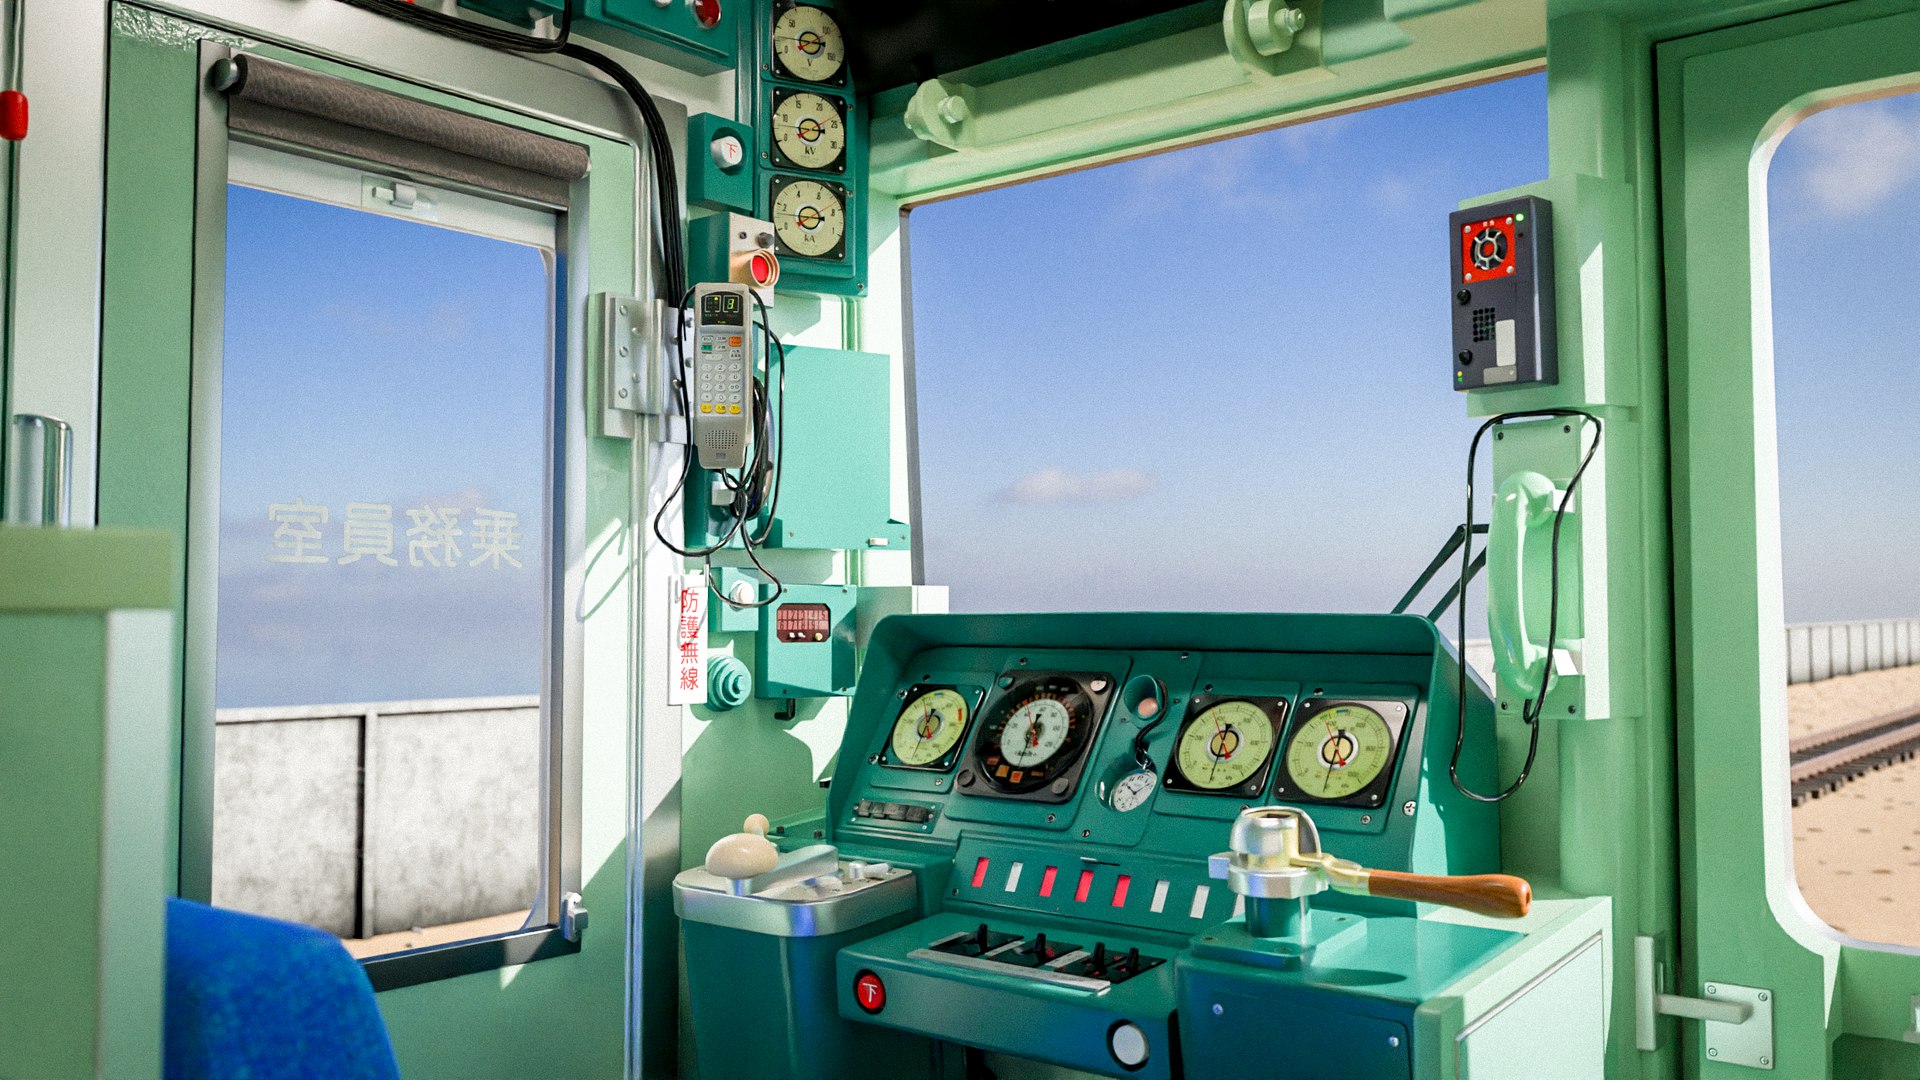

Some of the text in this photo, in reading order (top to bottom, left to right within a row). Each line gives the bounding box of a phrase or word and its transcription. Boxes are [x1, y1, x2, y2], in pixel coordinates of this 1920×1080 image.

[788, 19, 796, 28] 50
[815, 102, 823, 111] 20
[830, 120, 838, 129] 25
[726, 142, 738, 158] 下
[805, 146, 816, 155] kV
[680, 589, 699, 691] 防護無線
[862, 982, 877, 1003] 下
